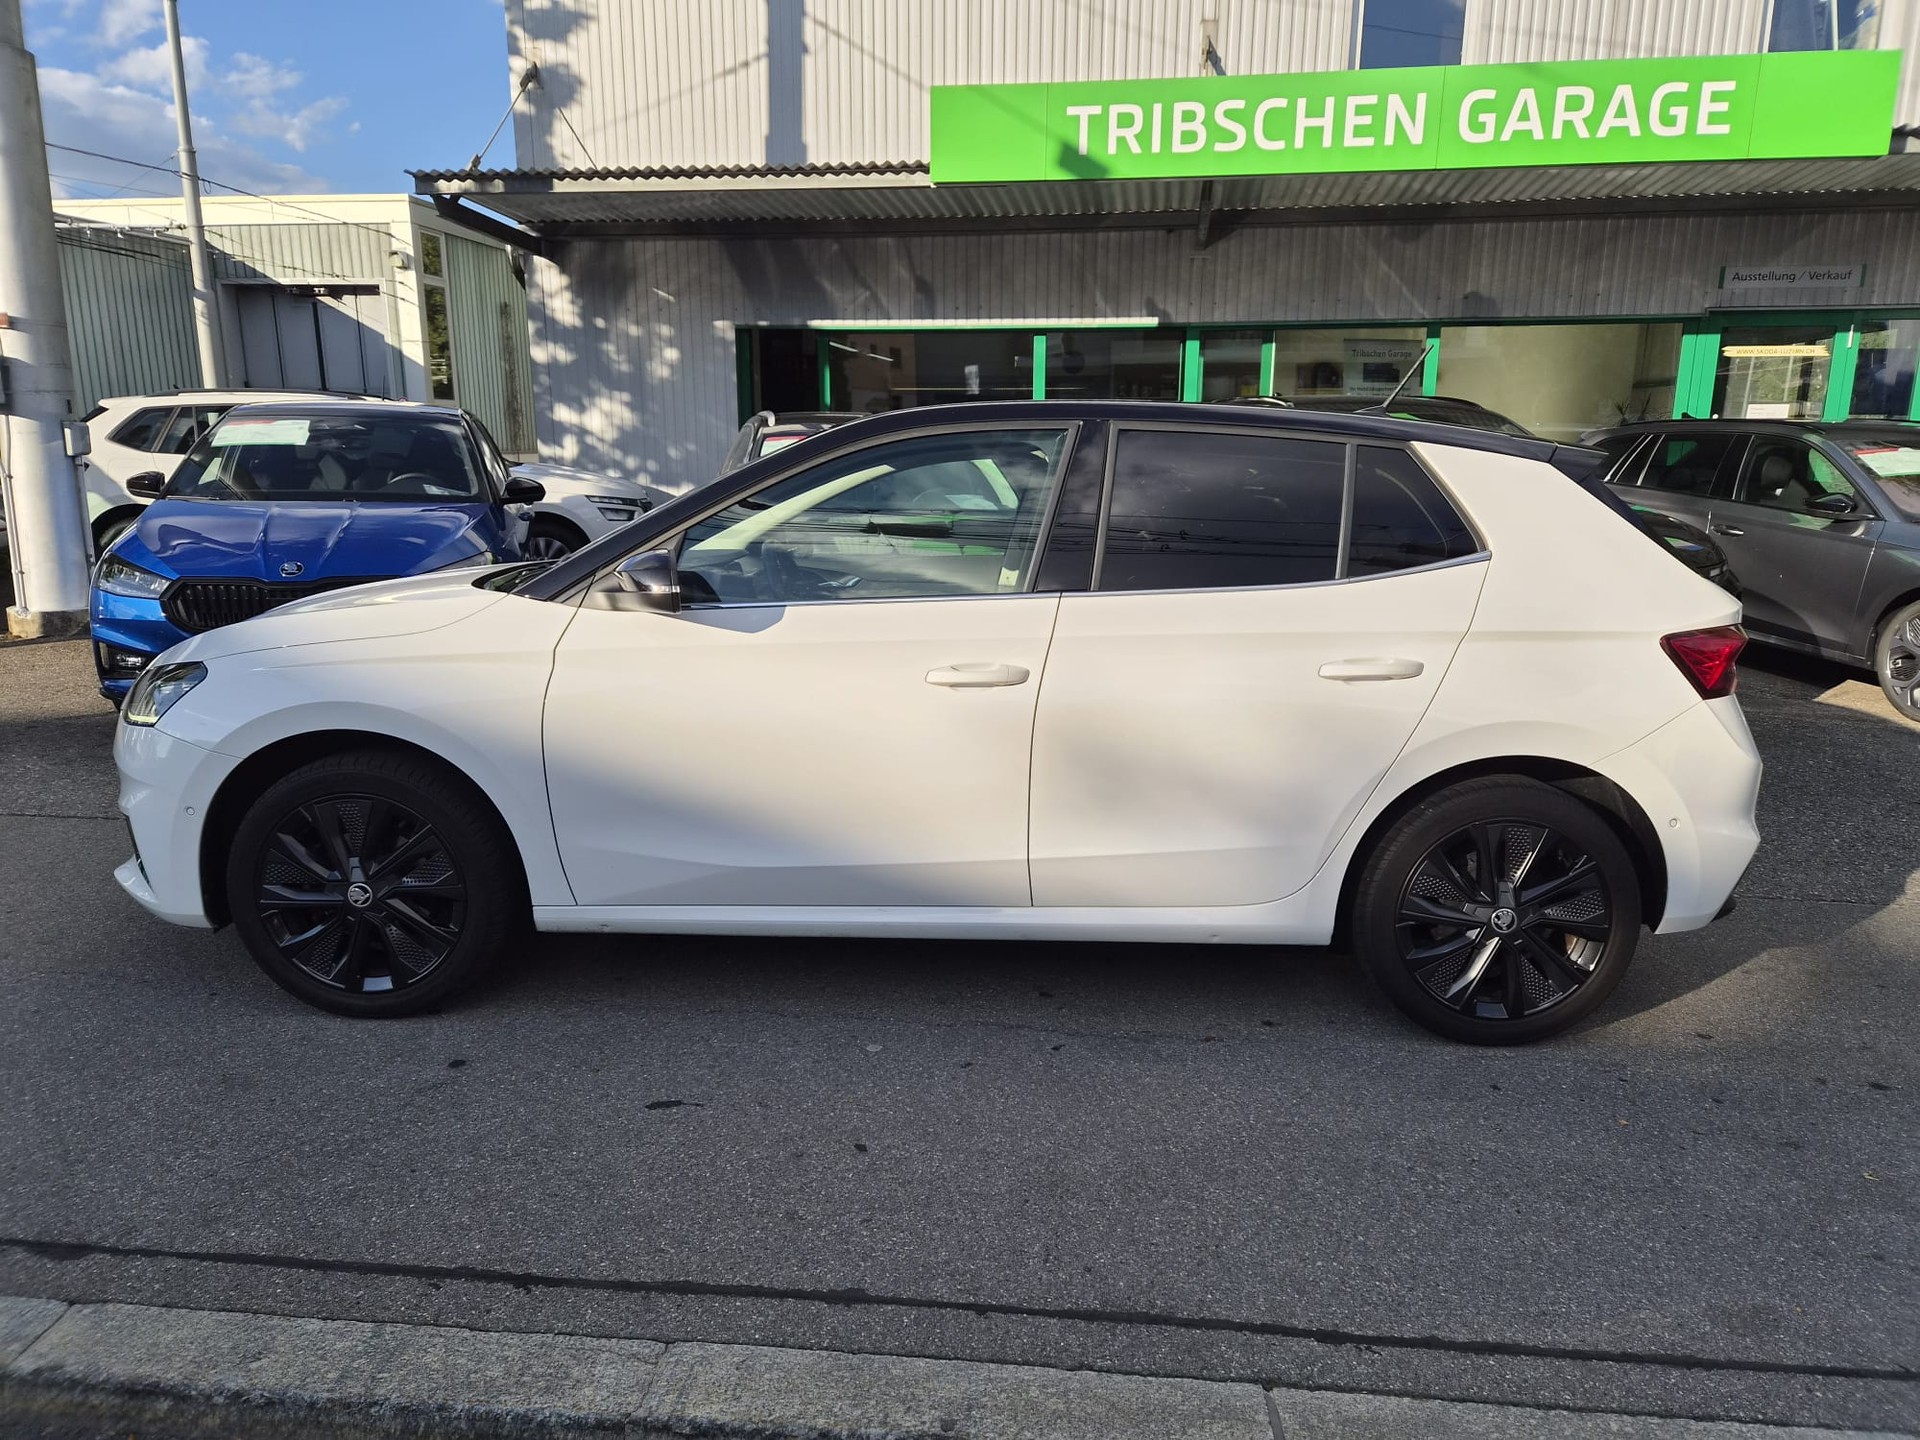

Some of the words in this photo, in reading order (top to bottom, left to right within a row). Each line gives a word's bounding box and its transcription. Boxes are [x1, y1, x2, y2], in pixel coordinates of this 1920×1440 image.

[1066, 92, 1428, 155] TRIBSCHEN
[1458, 80, 1737, 143] GARAGE
[1732, 270, 1796, 283] Ausstellung
[1808, 269, 1853, 281] Verkauf
[1351, 349, 1387, 358] Tribschen
[1387, 349, 1412, 359] Garage
